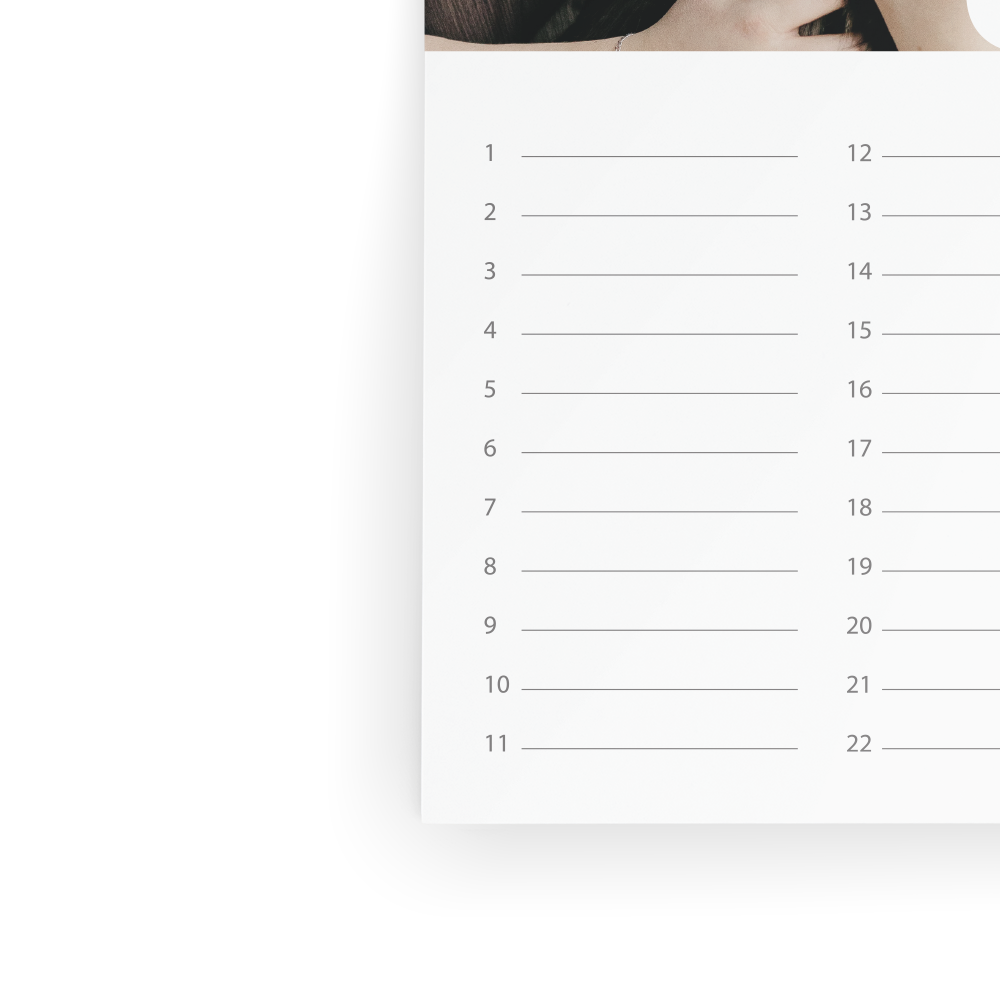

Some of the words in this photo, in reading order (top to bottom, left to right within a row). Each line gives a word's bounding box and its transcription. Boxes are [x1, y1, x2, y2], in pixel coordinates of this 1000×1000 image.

[485, 143, 493, 162] 1
[848, 143, 872, 162] 12
[484, 202, 497, 221] 2
[848, 202, 872, 222] 13
[484, 261, 496, 281] 3
[848, 261, 873, 280] 14
[483, 320, 497, 339] 4
[848, 320, 872, 340] 15
[484, 379, 496, 399] 5
[848, 379, 873, 399] 16
[483, 438, 497, 458] 6
[848, 439, 872, 458] 17
[484, 497, 497, 517] 7
[848, 497, 872, 517] 18
[483, 556, 497, 576] 8
[848, 556, 873, 576] 19
[483, 615, 497, 635] 9
[846, 616, 873, 635] 20
[485, 674, 510, 694] 10
[846, 675, 869, 694] 21
[485, 734, 506, 753] 11
[846, 734, 872, 753] 22
